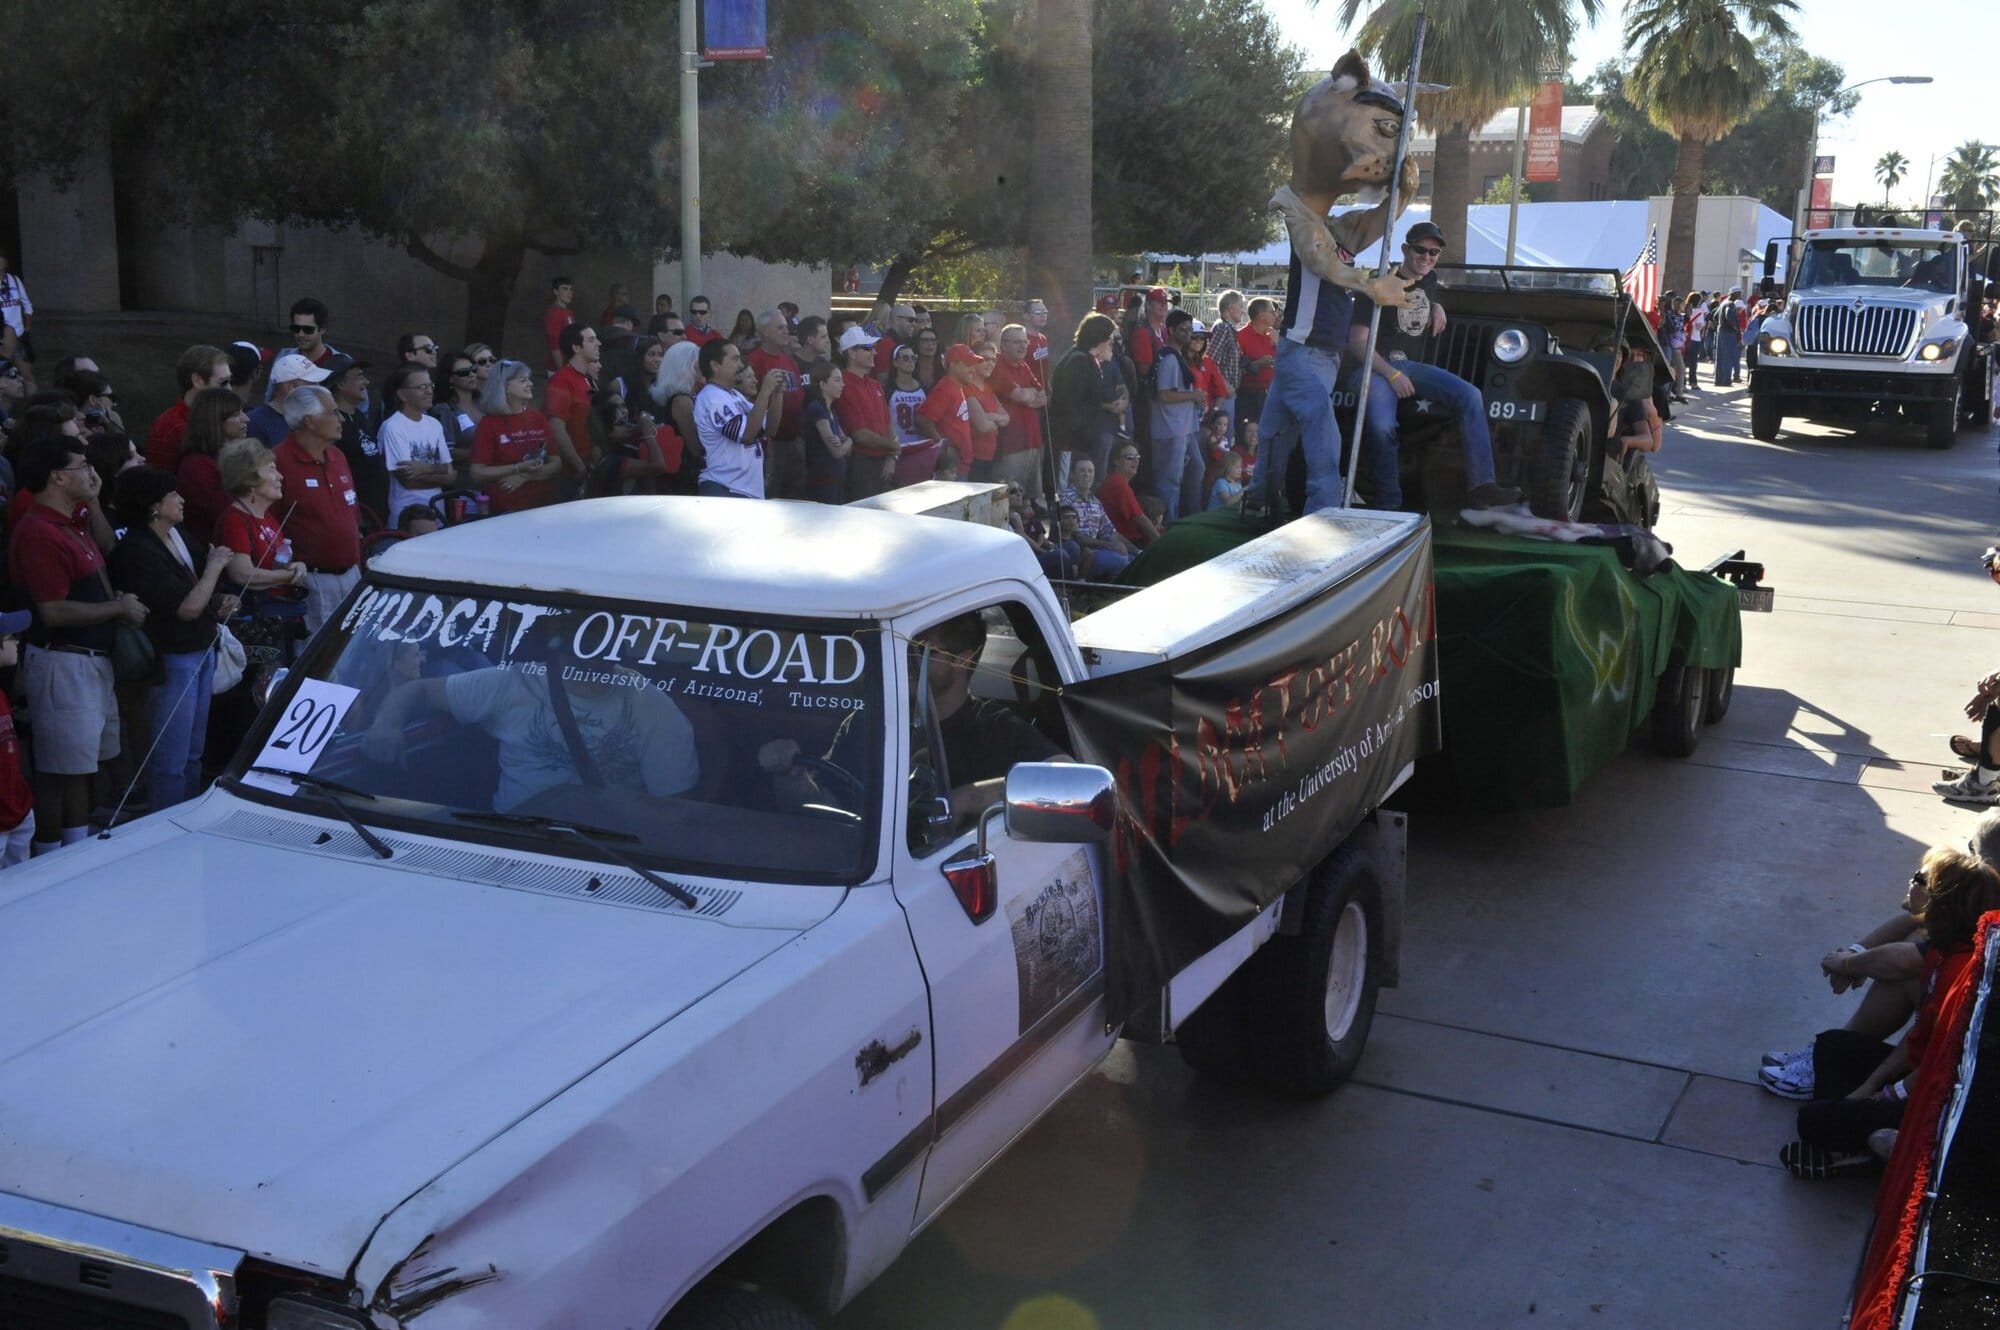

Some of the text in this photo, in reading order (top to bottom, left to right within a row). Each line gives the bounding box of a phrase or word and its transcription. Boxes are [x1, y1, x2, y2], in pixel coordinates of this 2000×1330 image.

[714, 404, 735, 425] 44
[1489, 401, 1537, 420] 89-1
[341, 585, 865, 684] WILDCAT OFF-ROAD
[497, 659, 513, 672] at
[521, 660, 547, 677] the
[562, 666, 651, 691] University
[656, 678, 676, 693] of
[789, 692, 865, 711] Tucson
[270, 698, 337, 756] 20
[1263, 805, 1274, 832] at
[1278, 790, 1296, 820] the
[1299, 745, 1358, 803] University
[1360, 727, 1373, 758] of
